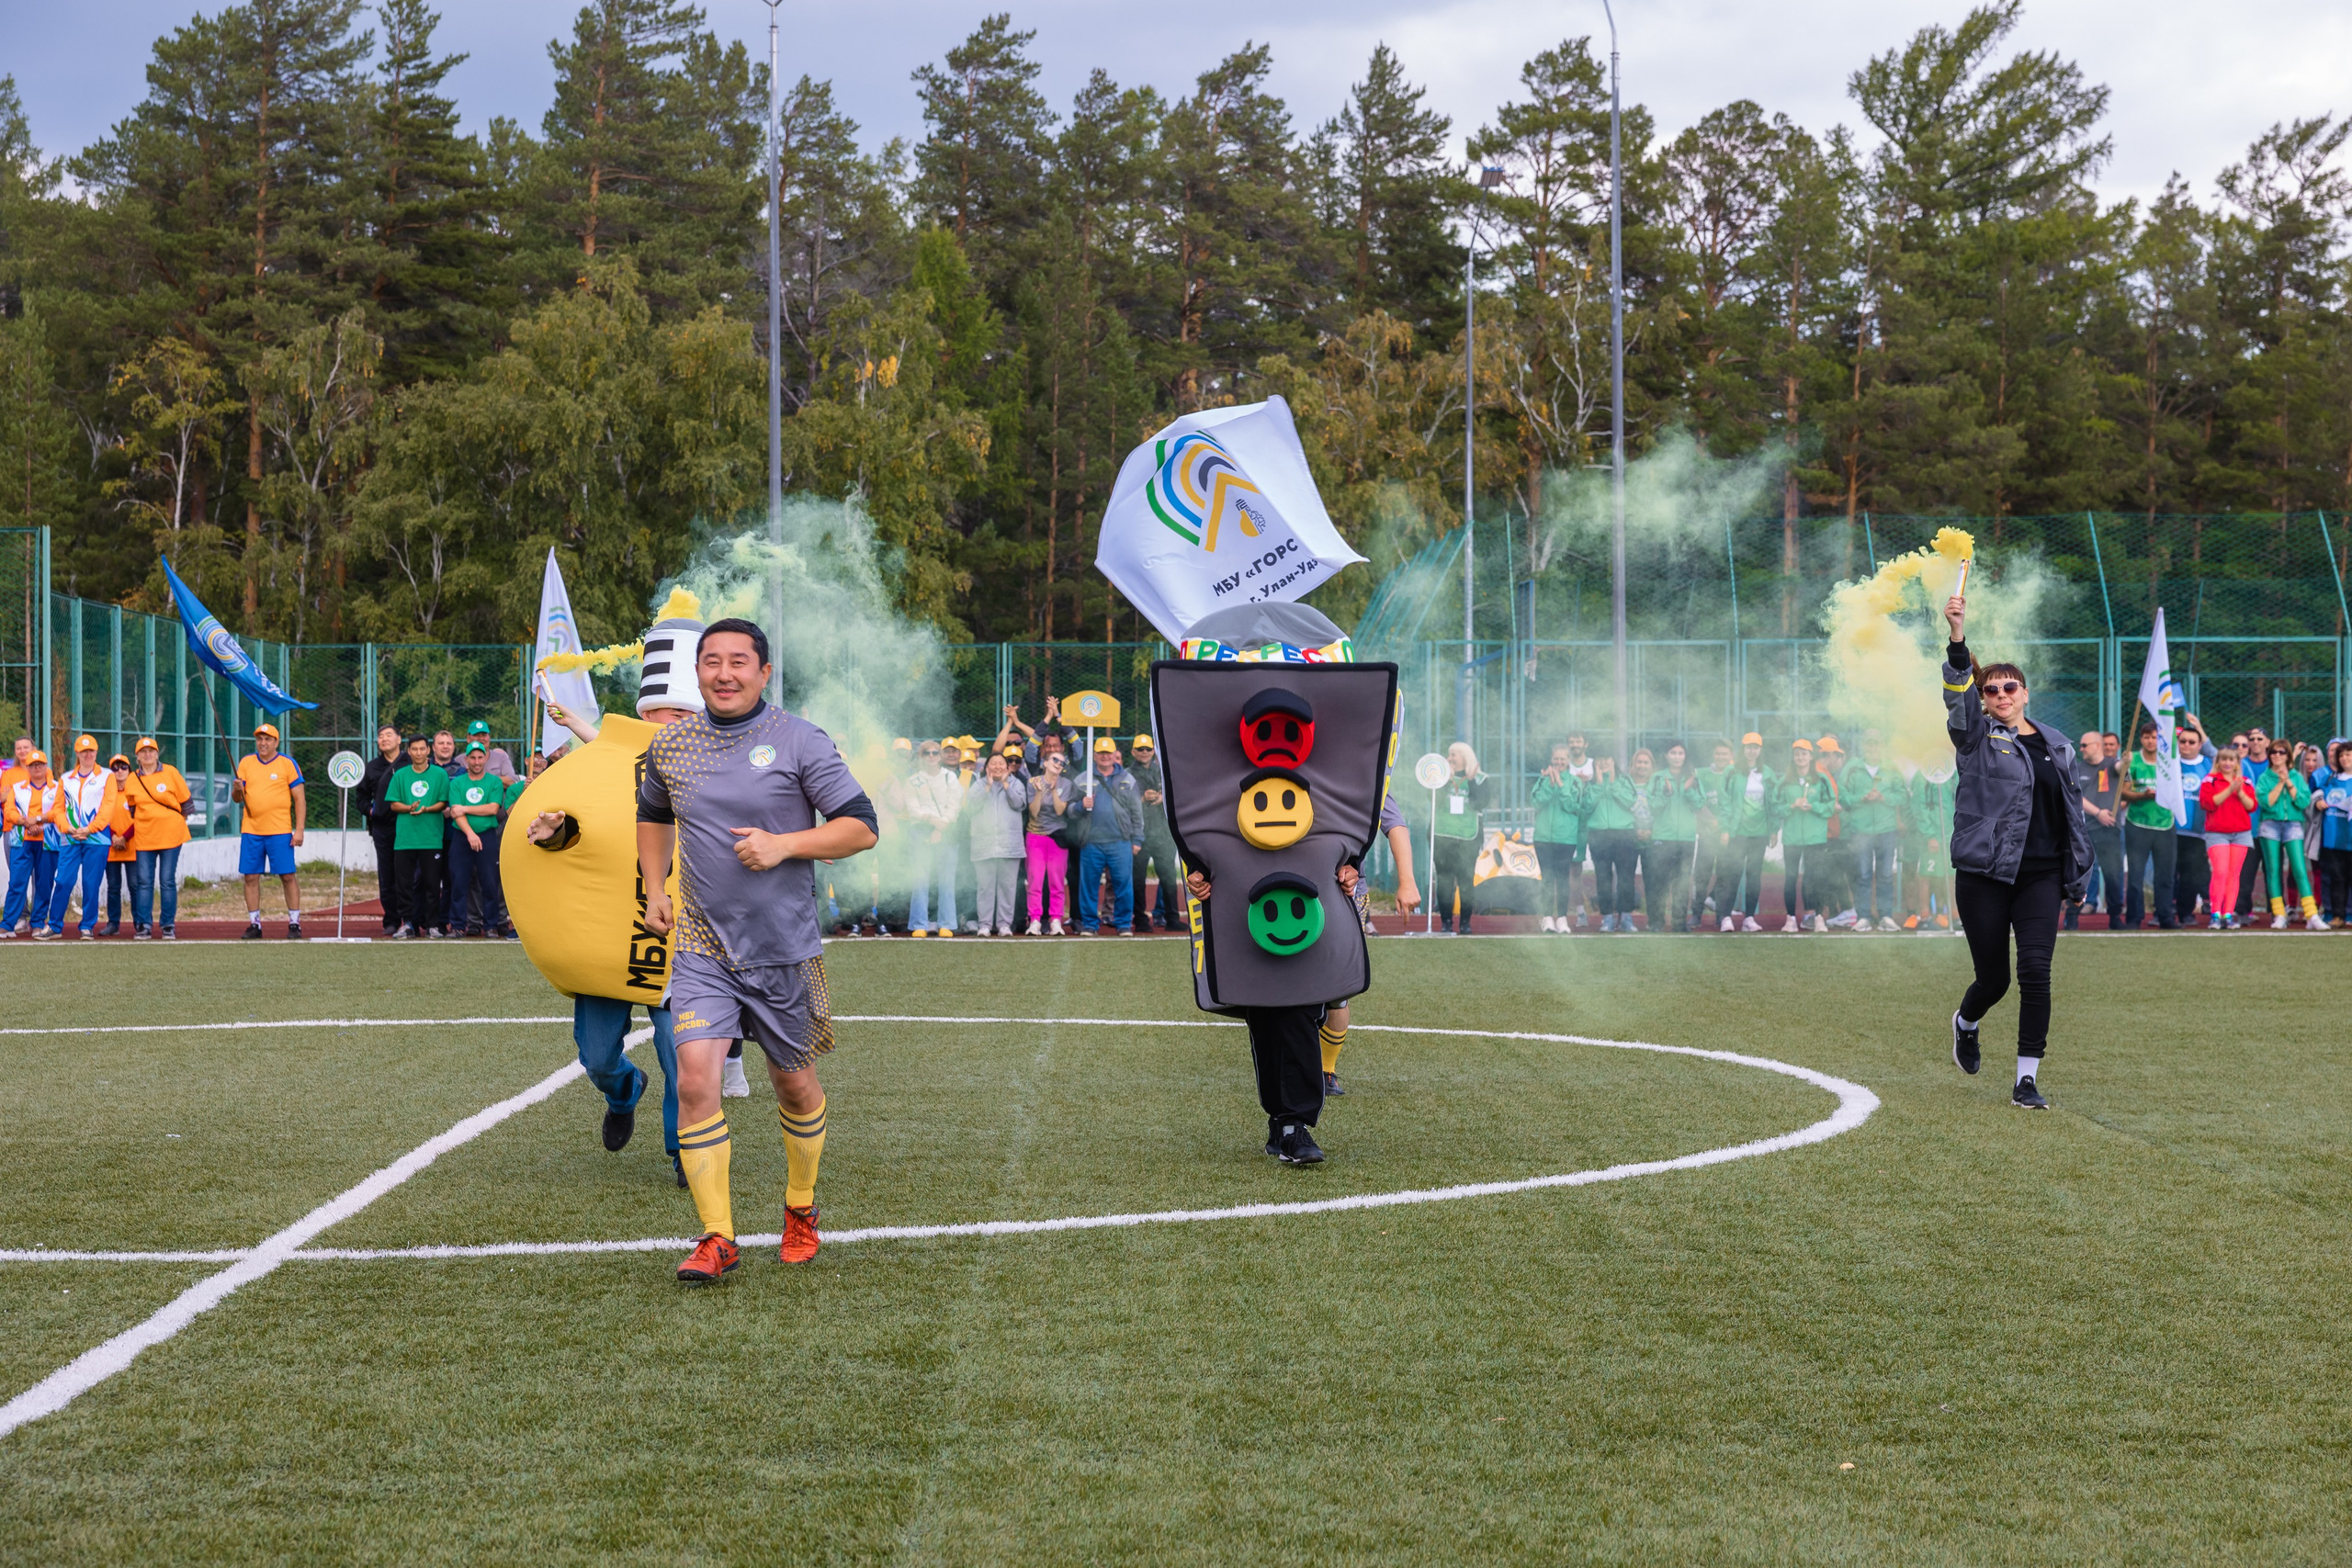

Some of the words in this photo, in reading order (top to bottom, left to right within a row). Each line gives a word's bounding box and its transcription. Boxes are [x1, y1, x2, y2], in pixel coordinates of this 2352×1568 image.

[1213, 571, 1240, 596] МБУ
[1246, 538, 1298, 579] «ГОРС
[1927, 860, 1936, 872] 2
[679, 1010, 695, 1021] МБУ
